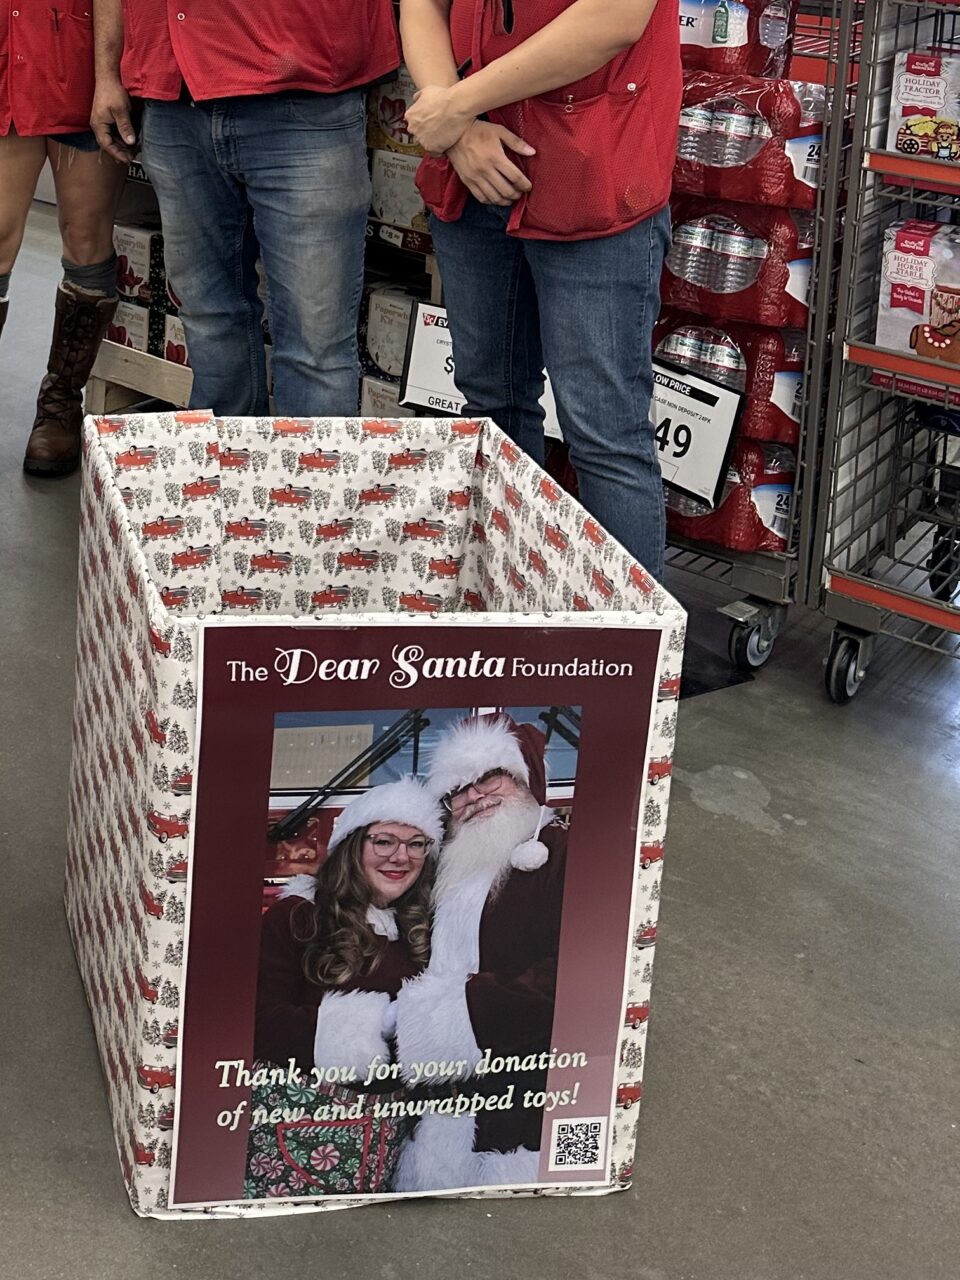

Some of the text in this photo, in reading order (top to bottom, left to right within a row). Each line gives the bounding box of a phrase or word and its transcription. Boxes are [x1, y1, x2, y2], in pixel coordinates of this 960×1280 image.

[904, 85, 941, 95] TRACTOR
[905, 78, 941, 87] HOLIDAY
[894, 255, 928, 267] HOLIDAY
[897, 262, 924, 272] HORSE
[669, 380, 692, 396] PRICE
[428, 396, 460, 412] GREAT
[655, 396, 667, 405] CASE
[667, 401, 678, 410] NON
[678, 406, 699, 418] DEPOSIT
[227, 644, 633, 689] The Dear Santa Foundation
[215, 1048, 589, 1089] Thank you for your donation
[216, 1082, 580, 1131] of new and unwrapped toys!
